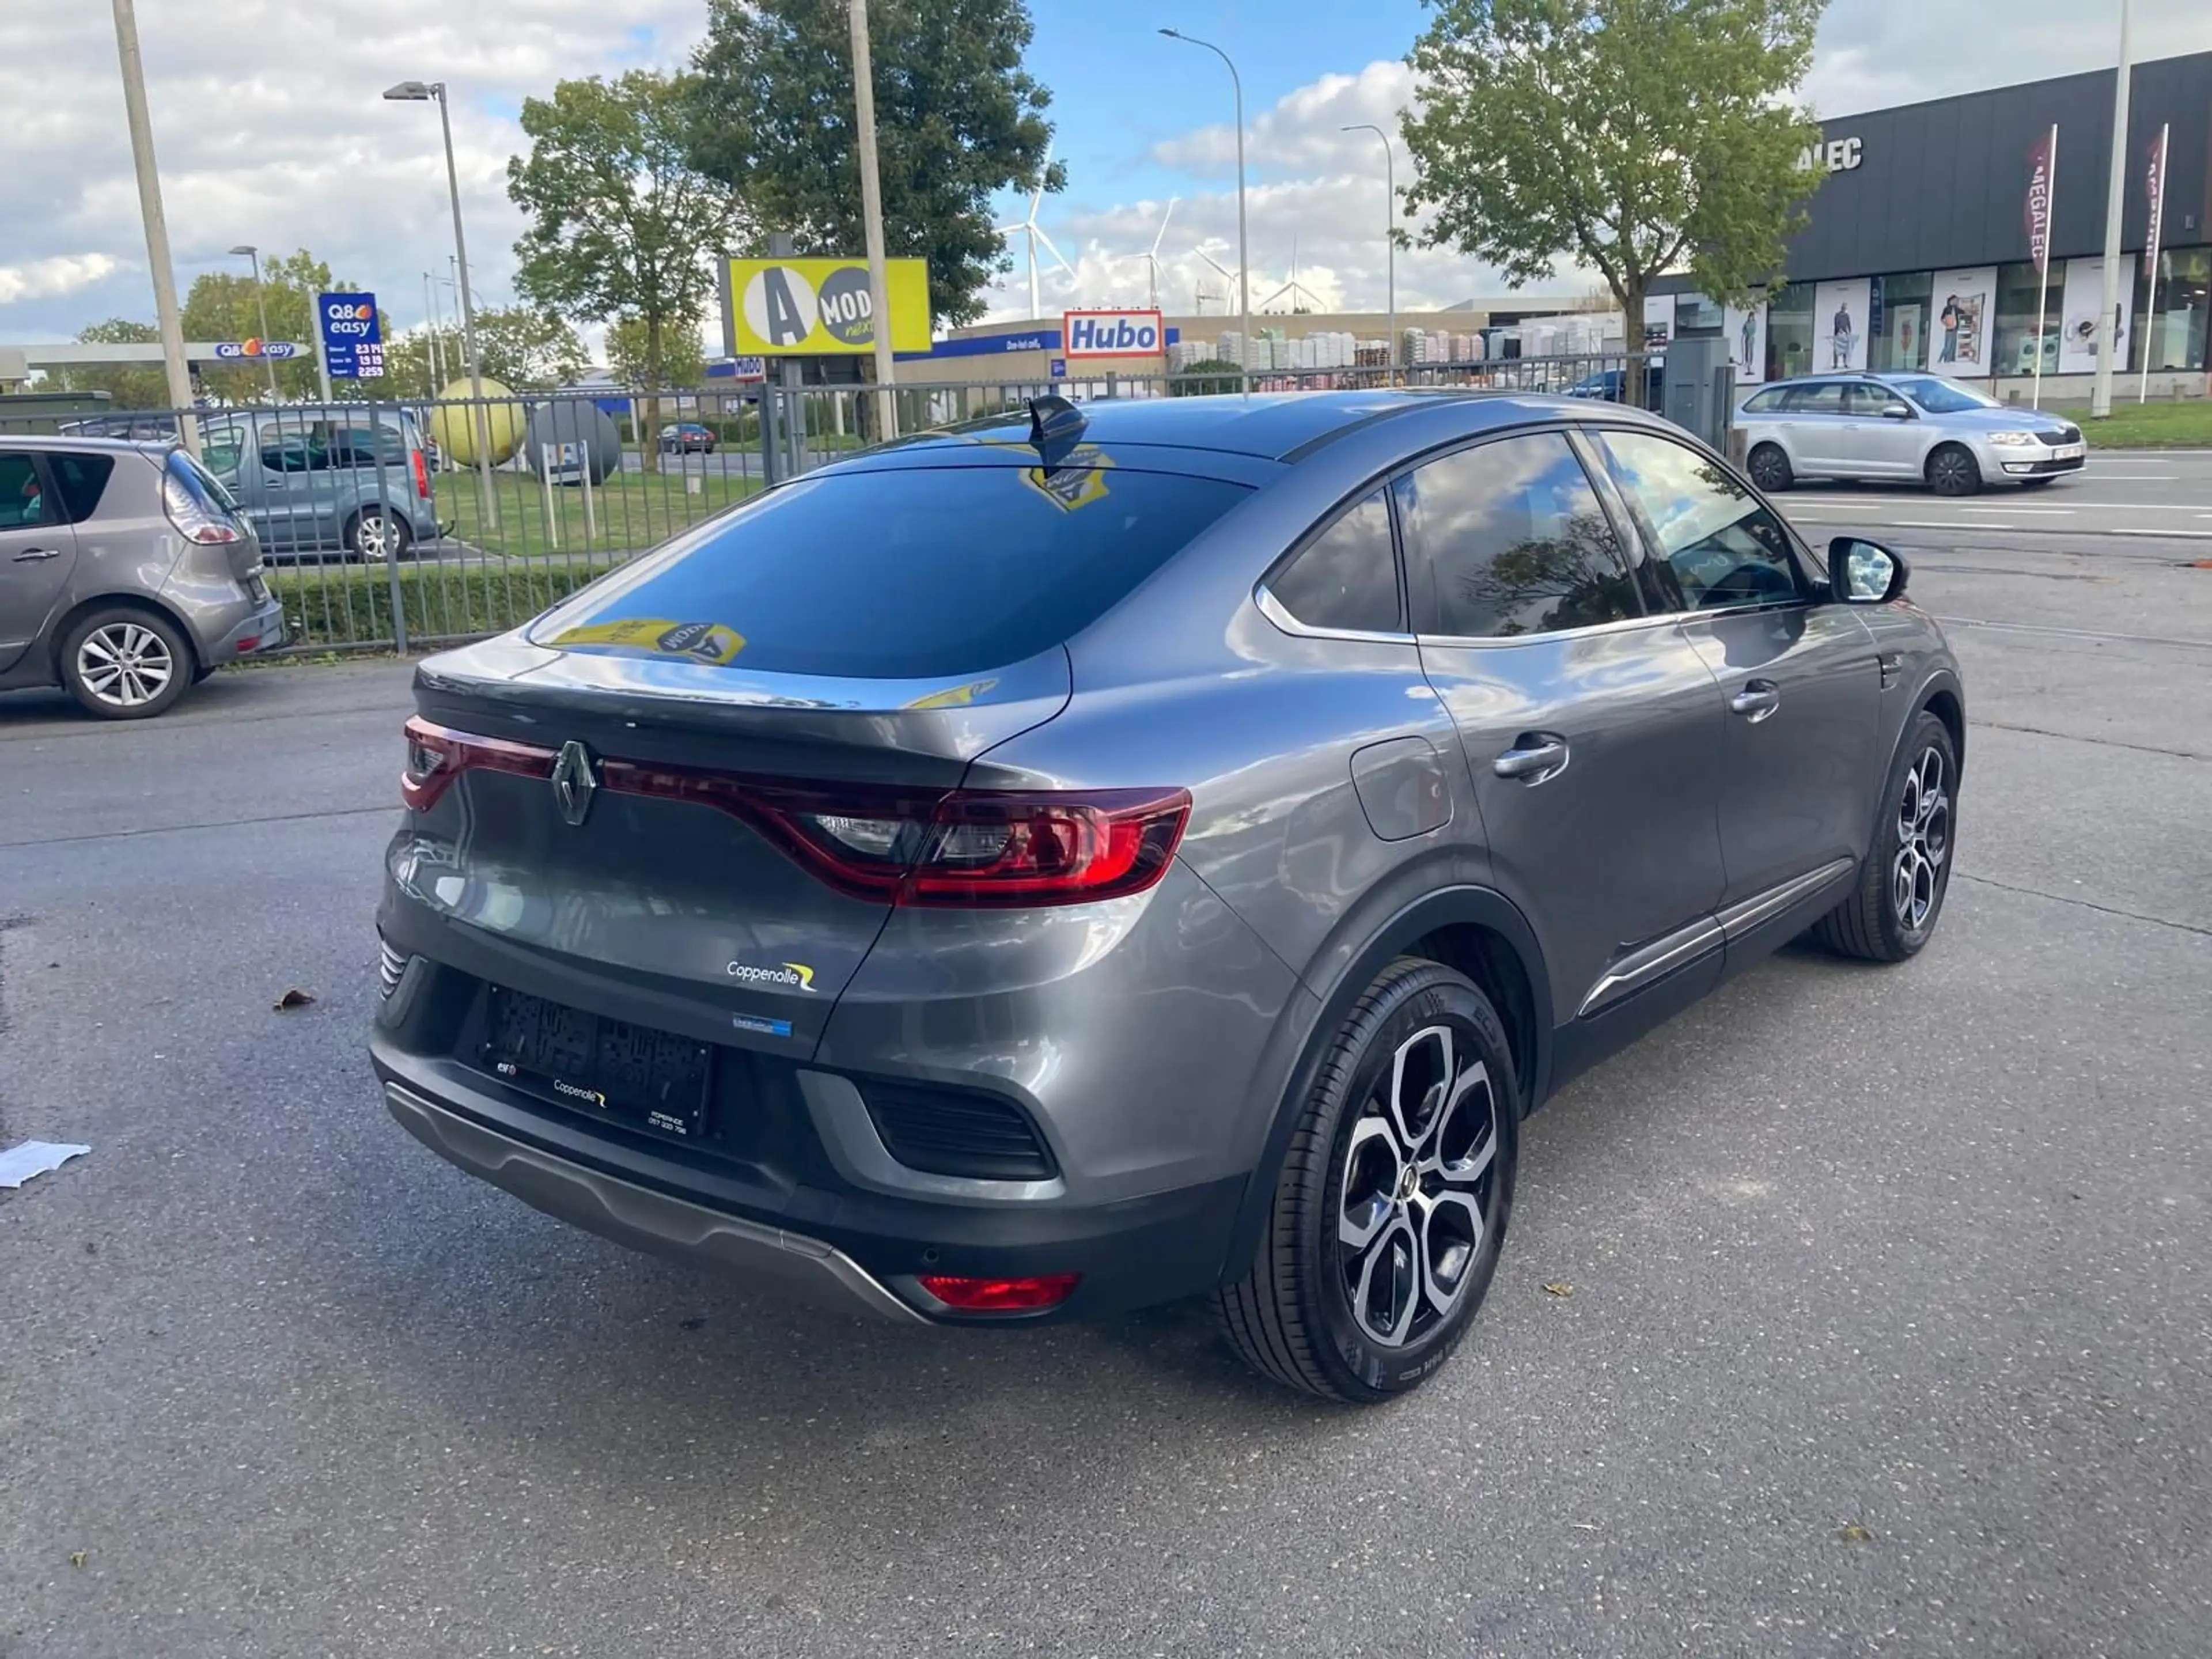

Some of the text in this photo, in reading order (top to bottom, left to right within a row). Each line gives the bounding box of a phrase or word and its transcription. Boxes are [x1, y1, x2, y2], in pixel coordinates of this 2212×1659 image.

[1797, 137, 1861, 172] ALEC
[328, 304, 354, 319] Q8
[820, 290, 872, 325] MOD
[330, 321, 370, 336] easy
[1071, 319, 1156, 349] Hubo
[221, 346, 240, 356] Q8
[727, 960, 798, 984] Coppenolle
[554, 1079, 596, 1102] Coppenolle
